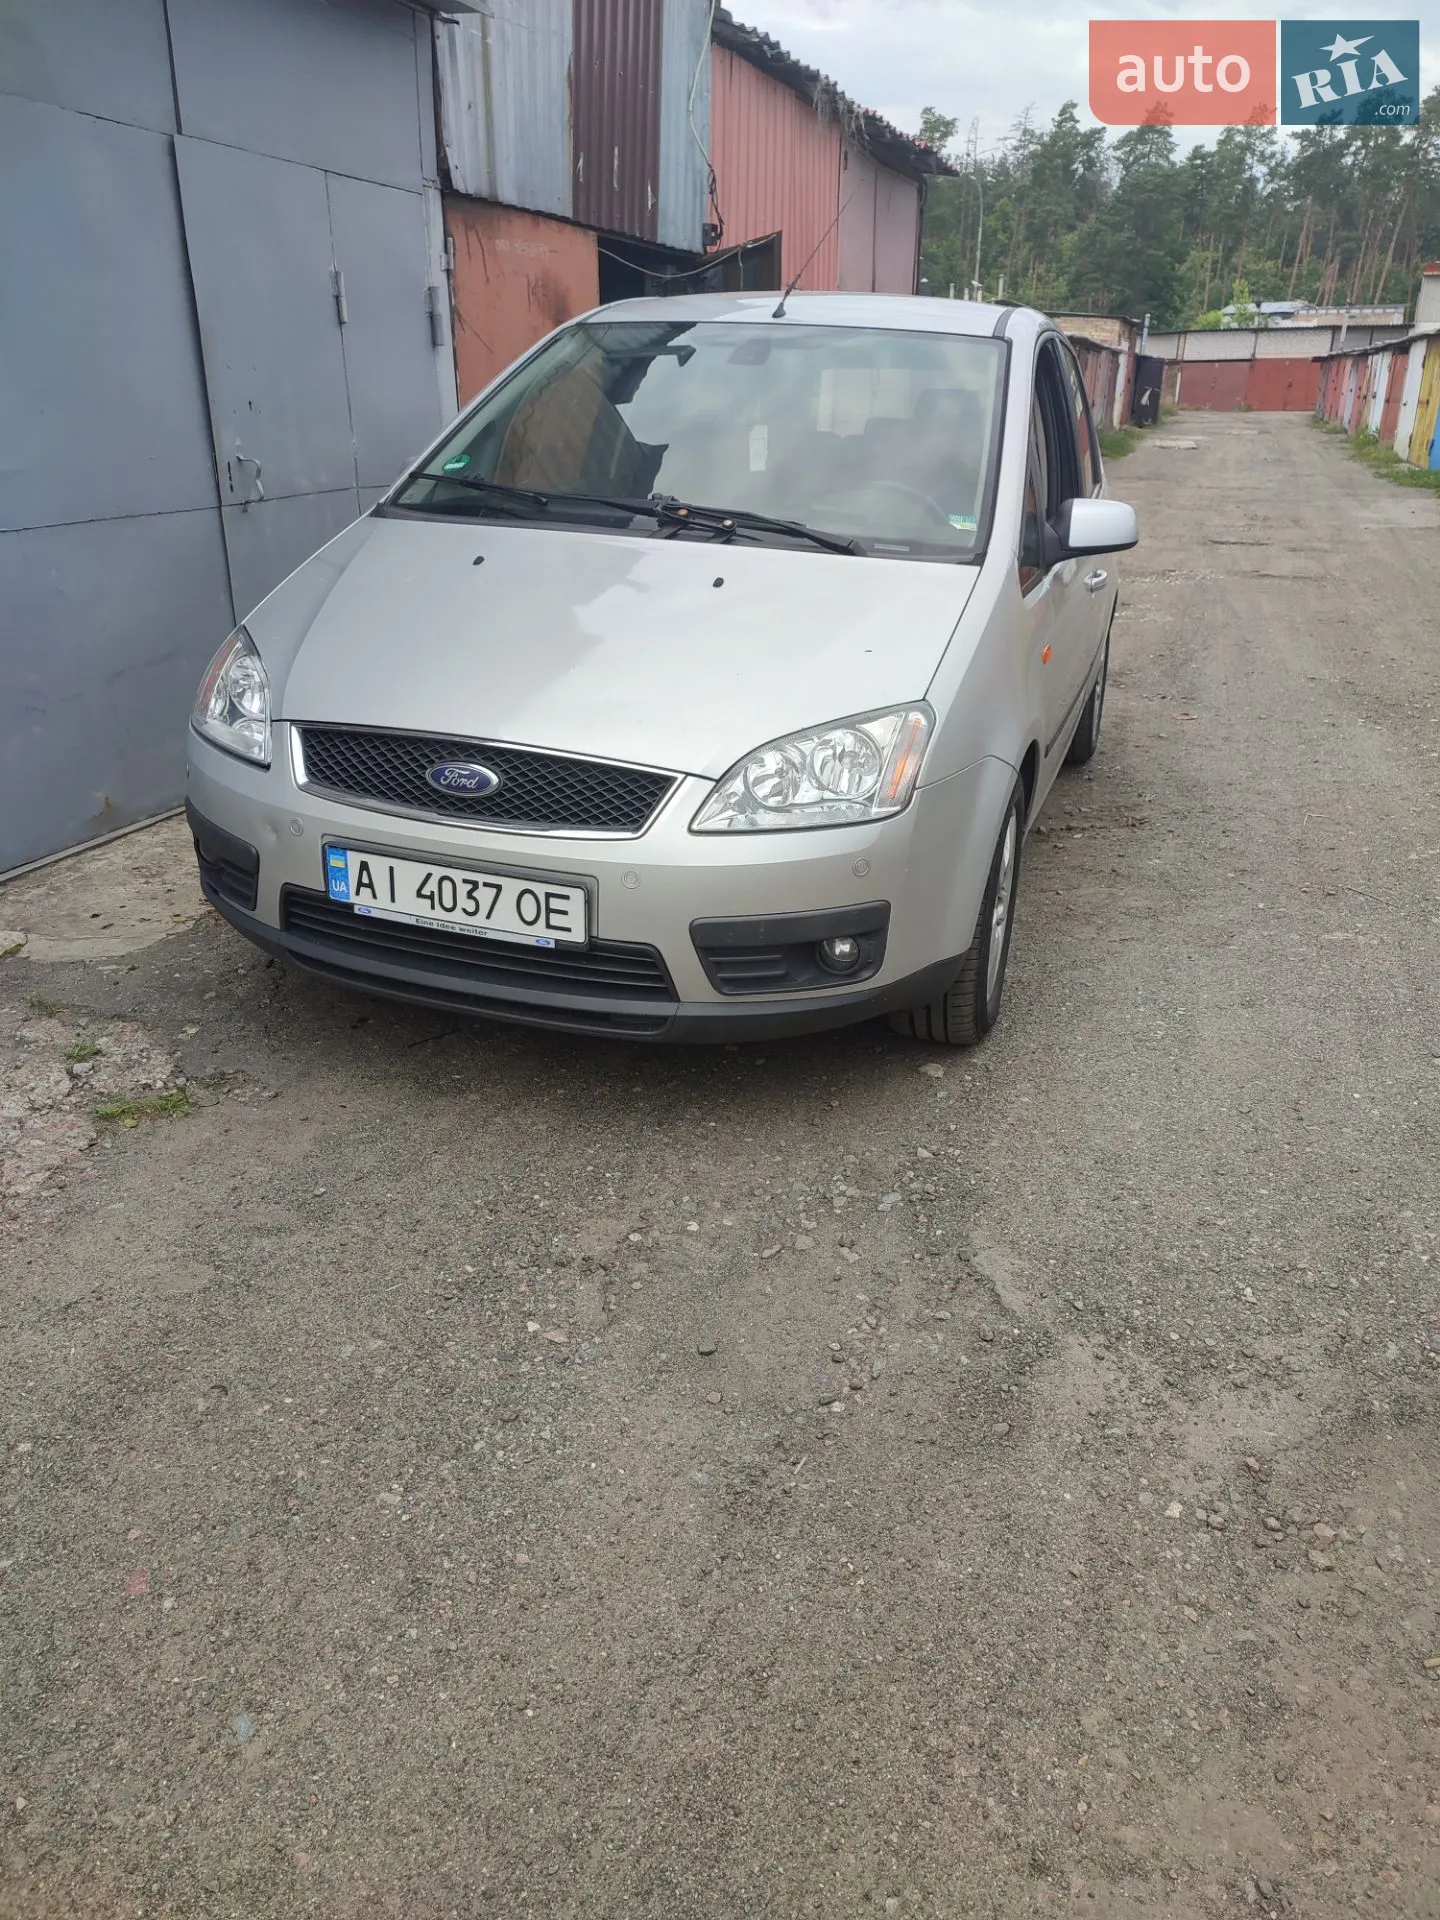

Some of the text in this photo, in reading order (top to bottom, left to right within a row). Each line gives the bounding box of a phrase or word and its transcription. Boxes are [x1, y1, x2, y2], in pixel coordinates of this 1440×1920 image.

[440, 768, 479, 789] Ford
[332, 879, 347, 892] UA
[355, 860, 572, 933] AI 4037 OE
[415, 918, 433, 928] Eine
[459, 926, 488, 936] weiter
